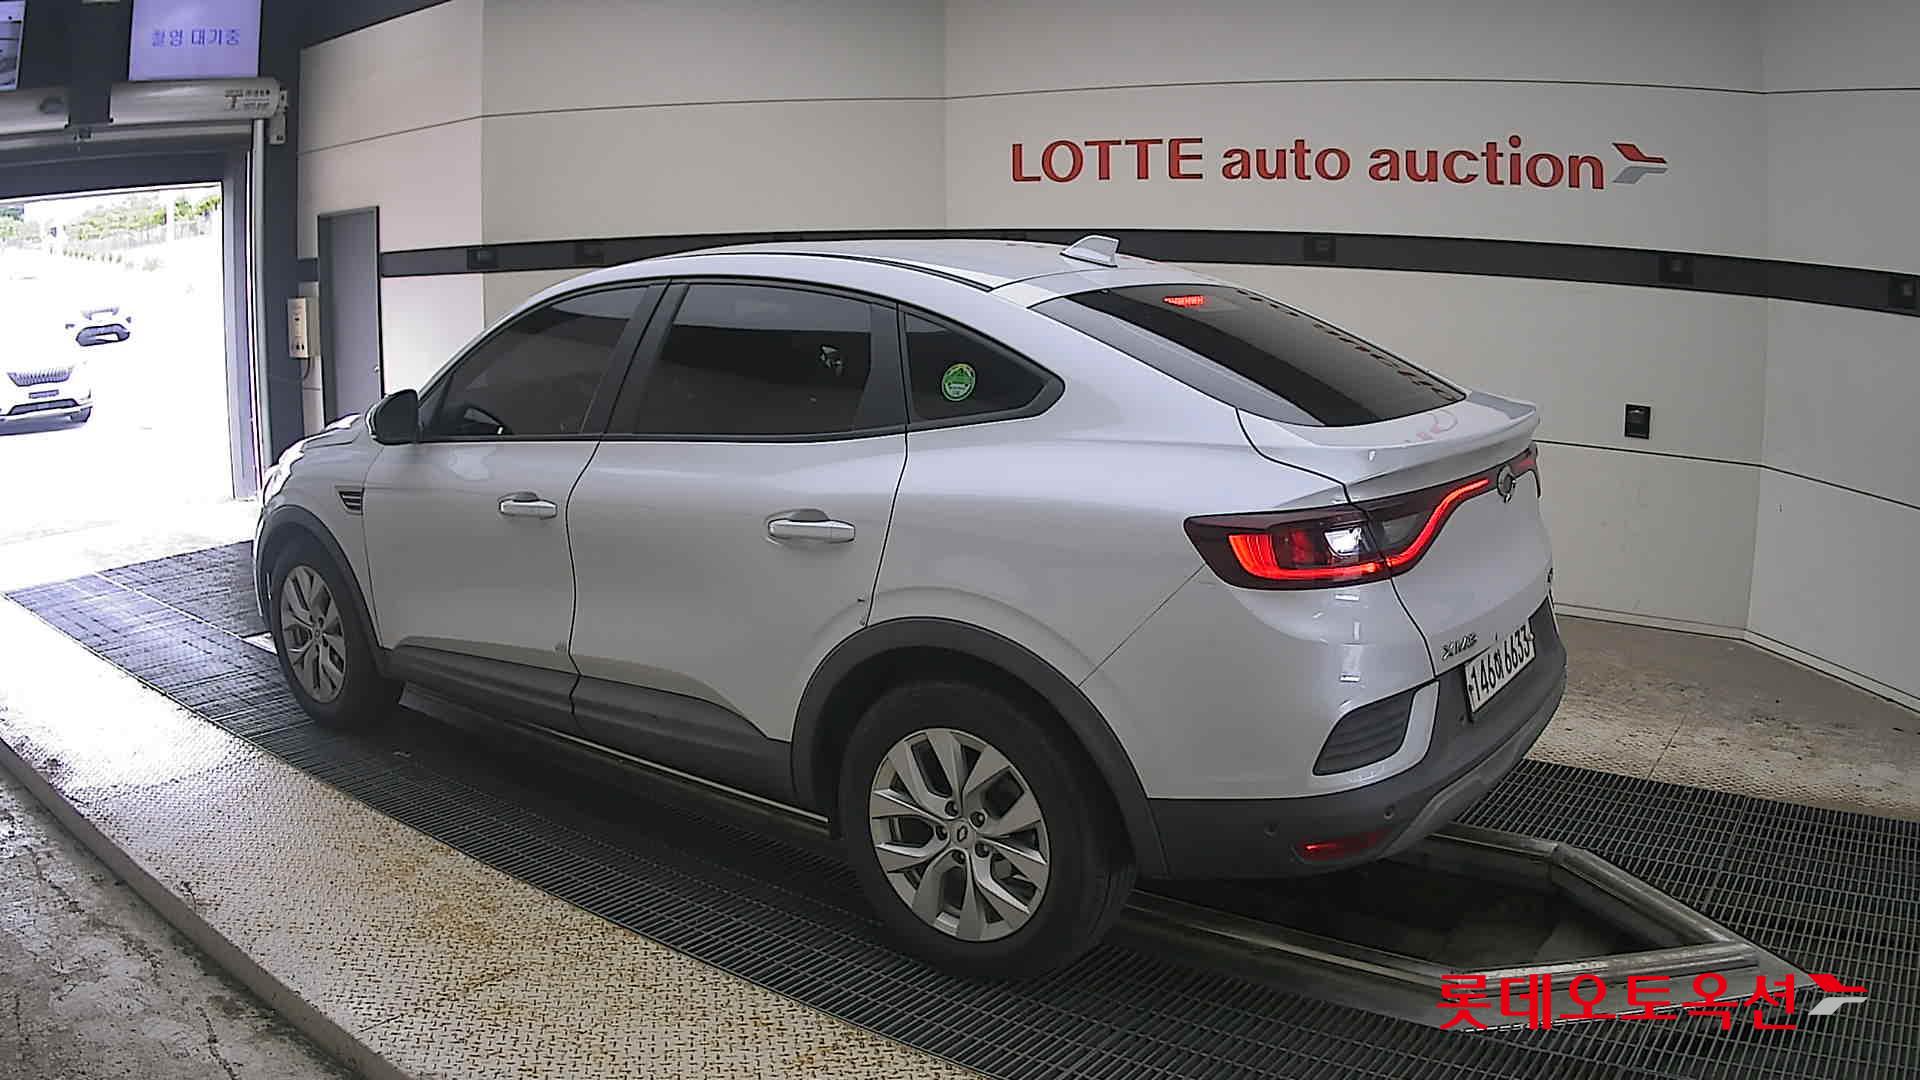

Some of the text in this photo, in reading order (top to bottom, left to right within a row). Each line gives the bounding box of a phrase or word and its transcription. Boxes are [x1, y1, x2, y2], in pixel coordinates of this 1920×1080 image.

[192, 28, 240, 46] 대기중
[1012, 135, 1604, 189] LOTTE auto auction
